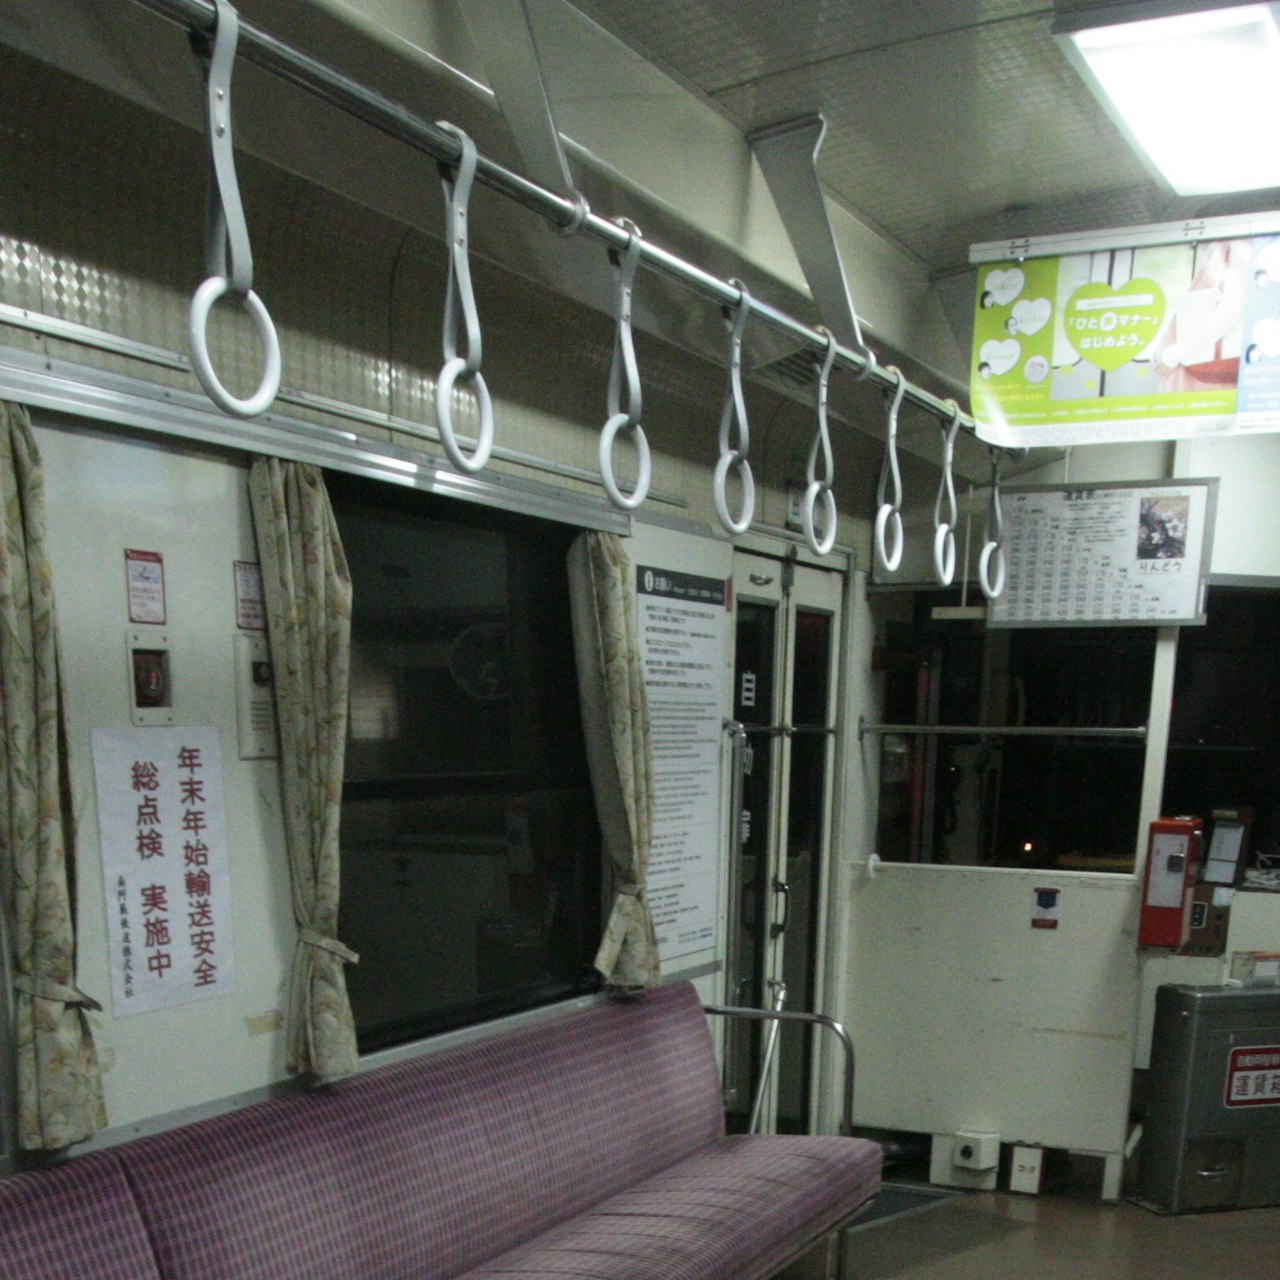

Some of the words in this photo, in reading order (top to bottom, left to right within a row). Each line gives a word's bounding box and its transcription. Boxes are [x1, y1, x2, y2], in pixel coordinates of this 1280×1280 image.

[1140, 561, 1182, 572] りんどう
[131, 760, 164, 860] 総点検
[177, 745, 218, 988] 年末年始輸送安全
[140, 883, 172, 979] 実施中
